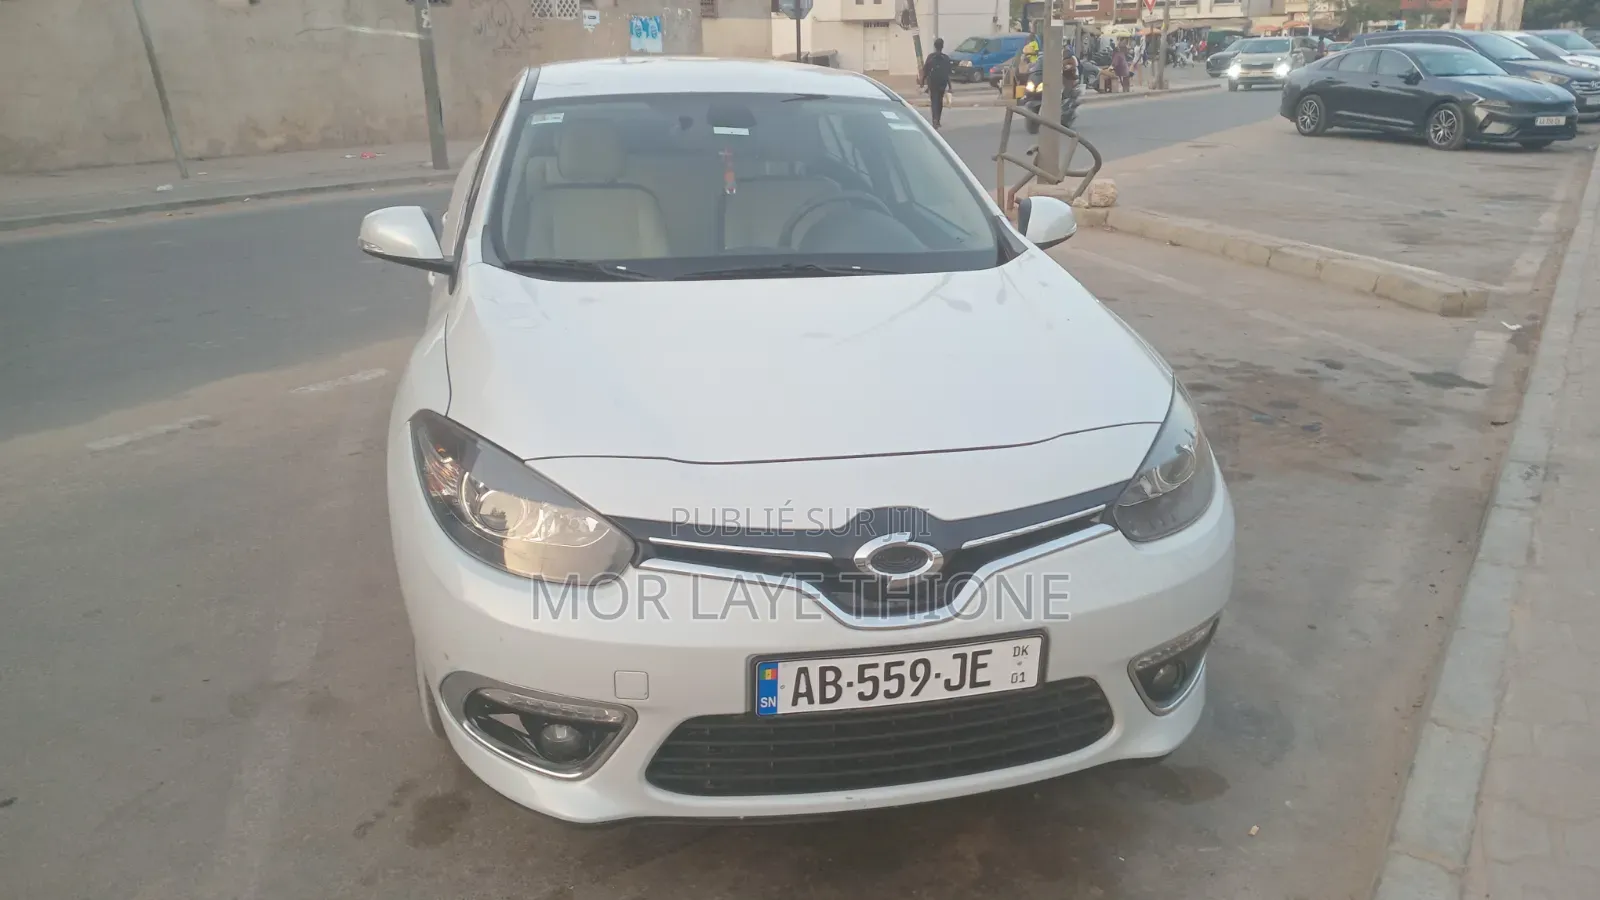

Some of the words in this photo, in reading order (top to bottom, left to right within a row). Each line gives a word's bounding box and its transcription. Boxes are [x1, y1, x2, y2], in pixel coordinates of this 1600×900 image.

[1012, 645, 1029, 658] DK
[1010, 671, 1026, 684] 01
[760, 697, 777, 708] SN
